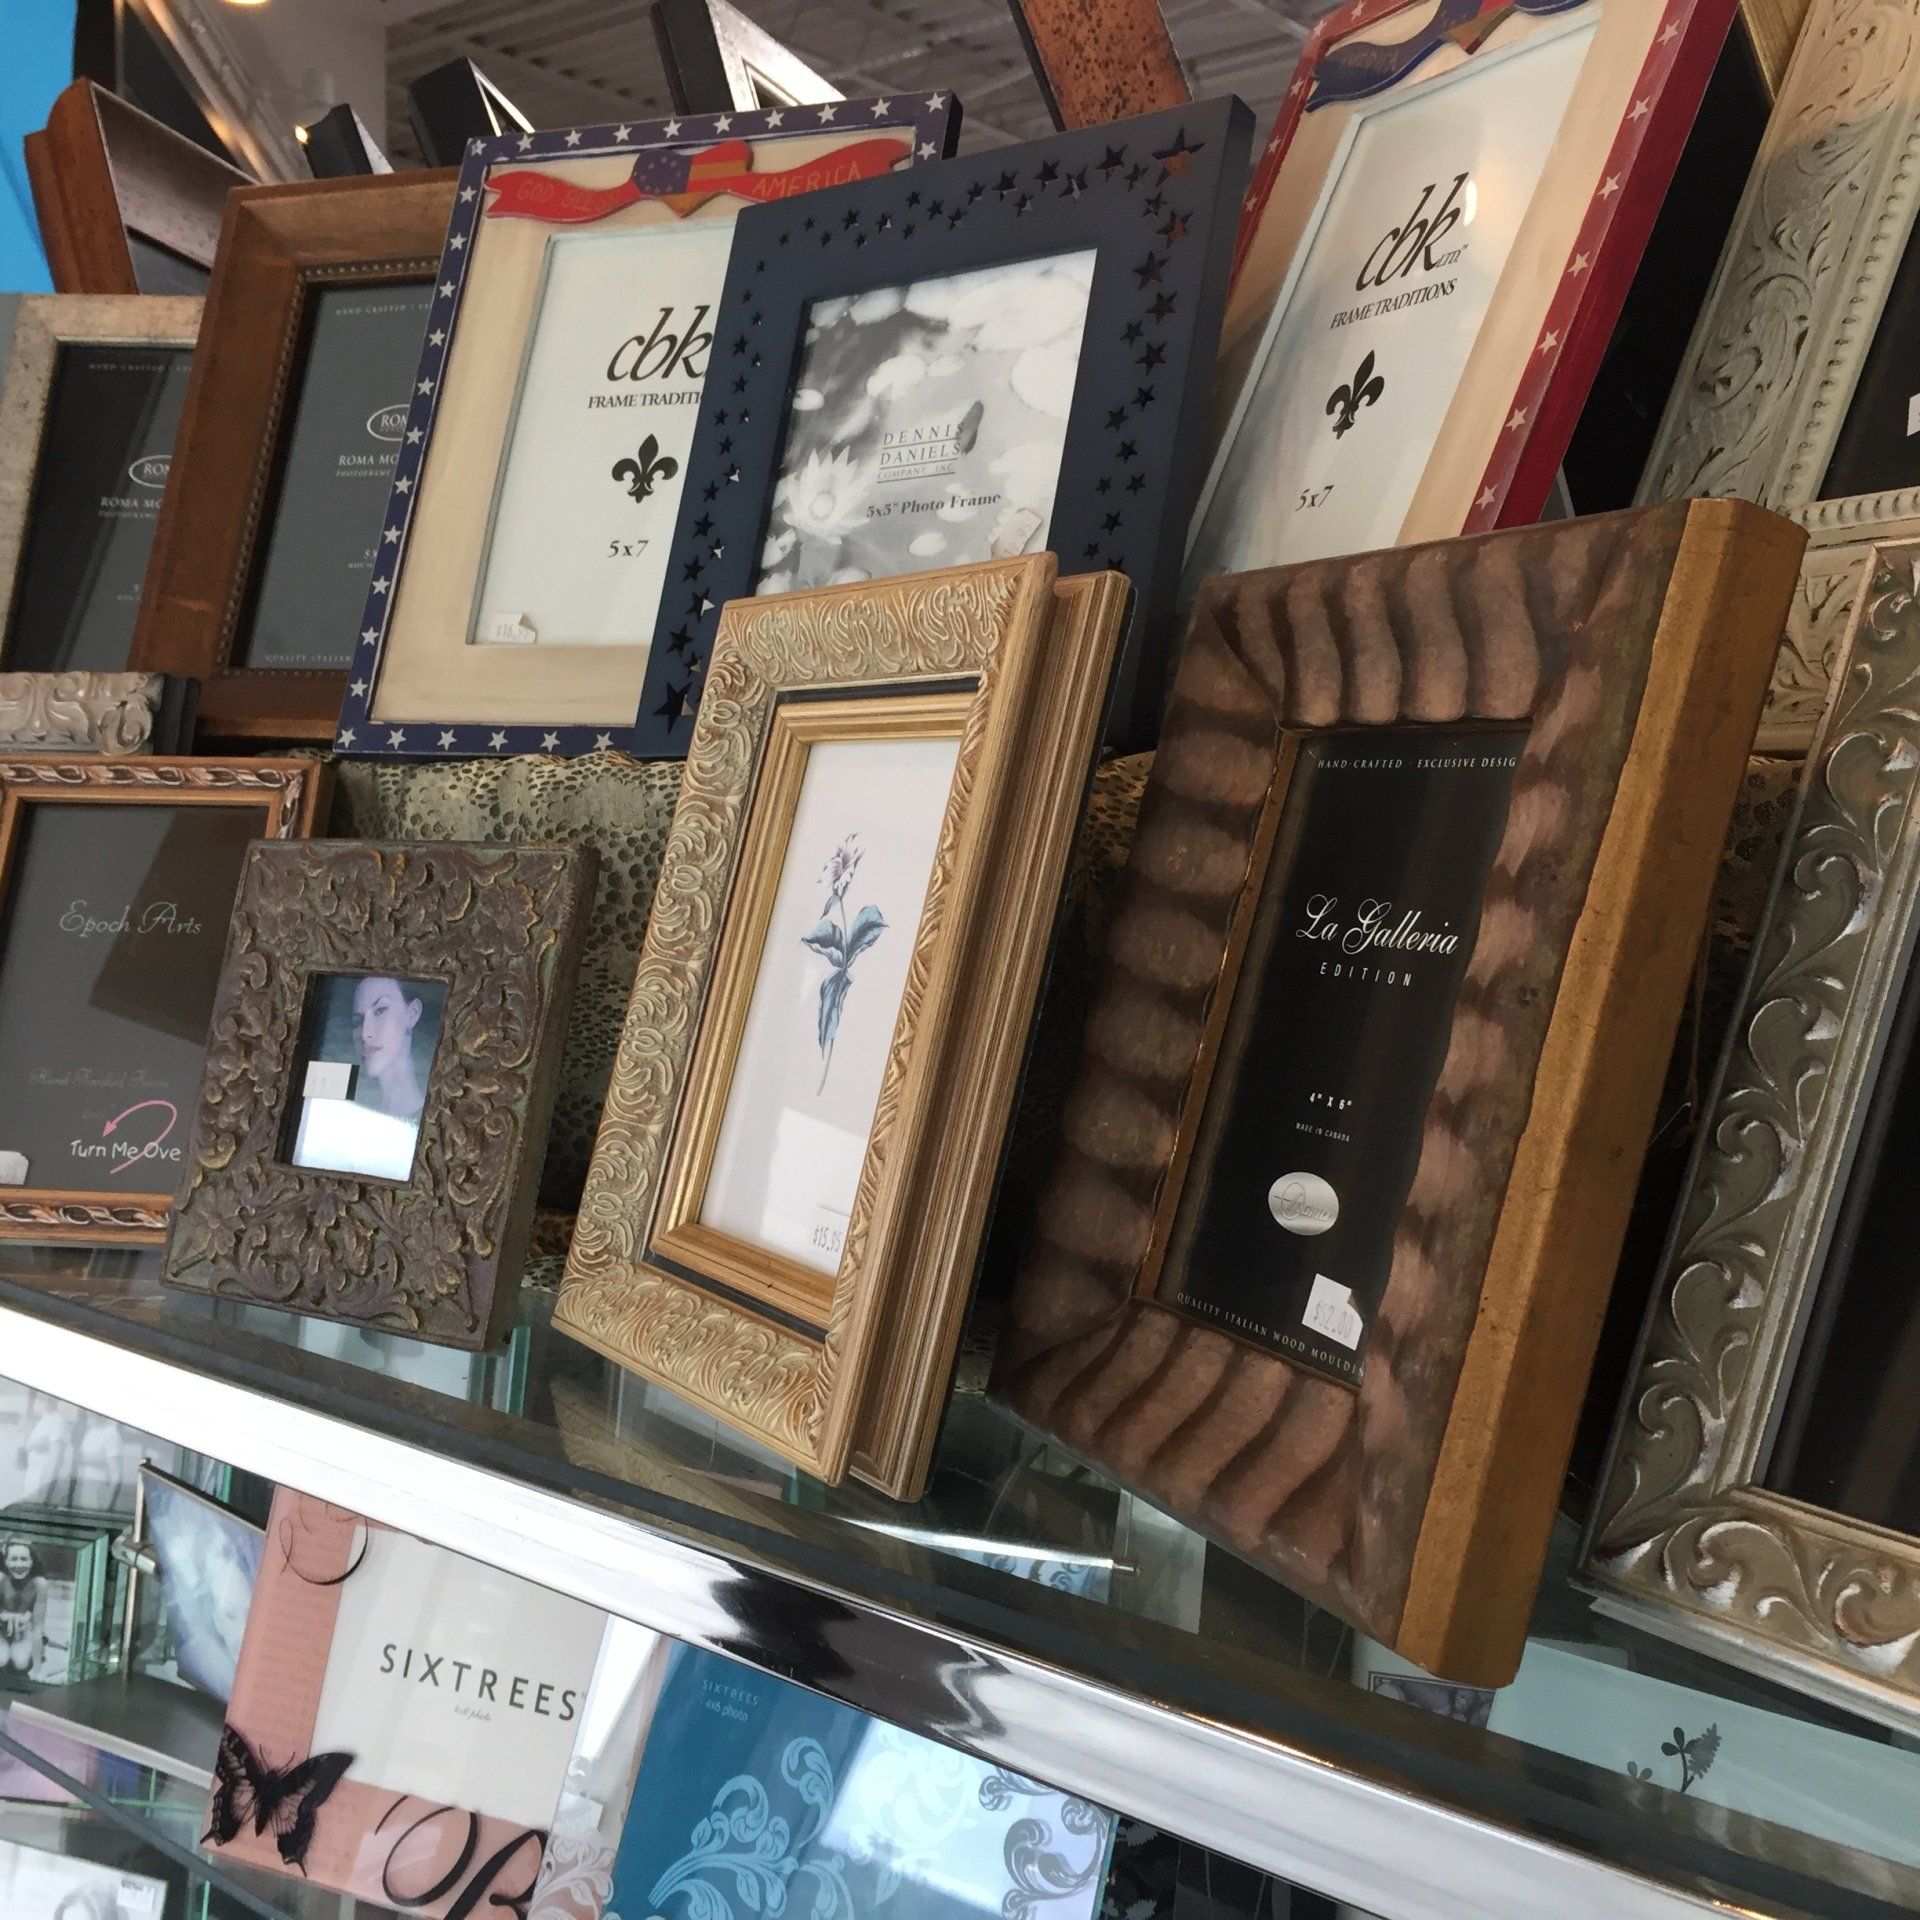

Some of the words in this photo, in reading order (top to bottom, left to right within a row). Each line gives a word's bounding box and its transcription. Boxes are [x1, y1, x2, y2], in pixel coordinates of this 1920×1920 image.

[752, 160, 861, 197] AMERICA
[1356, 172, 1469, 291] cbk
[1330, 303, 1374, 329] FRAME
[1374, 278, 1458, 316] TRADITIONS
[607, 305, 712, 381] cbk
[587, 394, 638, 409] FRAME
[883, 422, 964, 446] DENNIS
[338, 455, 374, 467] ROMA
[880, 442, 961, 466] DANIELS
[901, 499, 945, 515] Photo
[950, 493, 1002, 509] Frame
[1417, 758, 1476, 768] EXCLUSIVE
[60, 899, 131, 938] Epoch
[137, 901, 202, 934] Arts
[1296, 894, 1339, 941] La
[1342, 899, 1459, 955] Galleria
[1320, 962, 1412, 987] EDITION
[70, 1139, 106, 1158] Turn
[112, 1142, 139, 1160] Me
[1177, 1292, 1221, 1317] QUALITY
[1225, 1311, 1267, 1336] ITALIAN
[1273, 1331, 1306, 1352] WOOD
[379, 1643, 577, 1721] SIXTREES
[702, 1679, 758, 1706] SIXTREES
